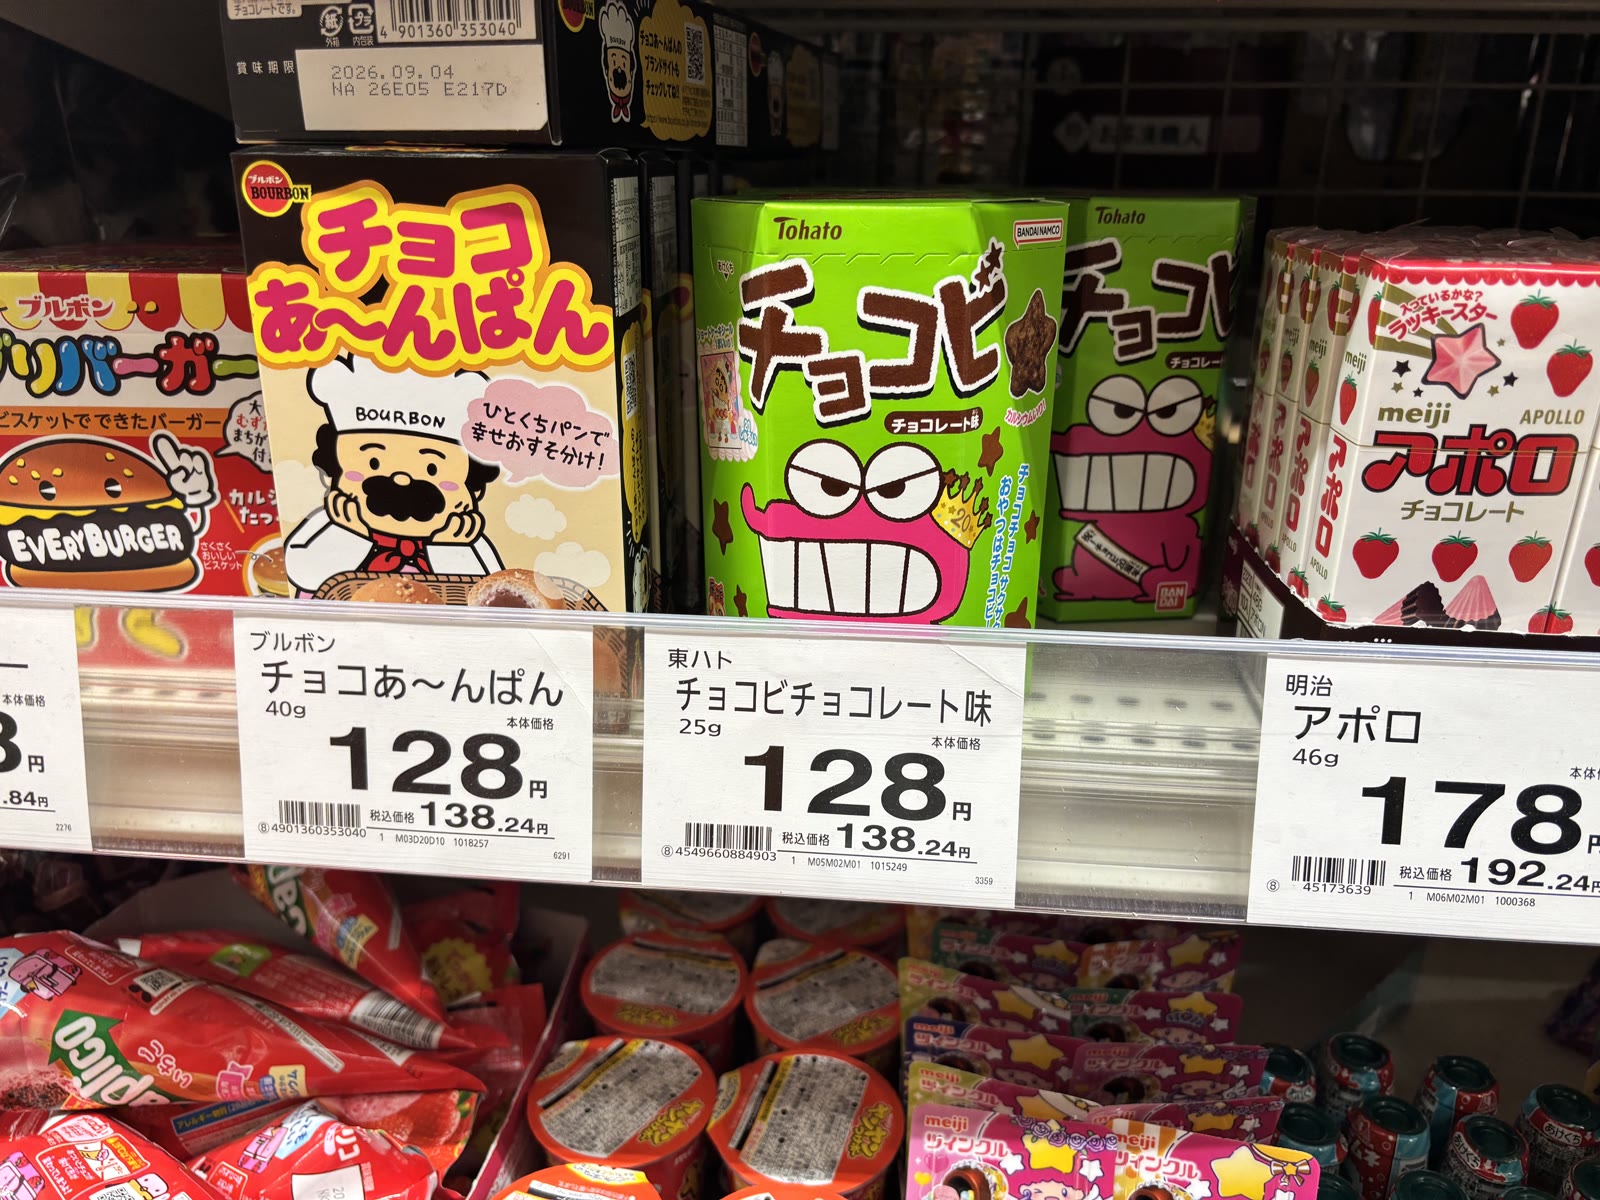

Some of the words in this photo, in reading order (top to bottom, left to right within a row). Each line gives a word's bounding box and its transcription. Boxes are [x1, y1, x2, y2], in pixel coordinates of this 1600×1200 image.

[380, 26, 388, 39] 4
[399, 23, 453, 39] 901360
[460, 22, 517, 38] 353040
[236, 60, 295, 76] 賞味期限
[331, 64, 455, 80] 2026.09.04
[332, 82, 355, 97] NA
[369, 82, 430, 97] 26E05
[443, 81, 507, 97] E217D
[248, 174, 283, 185] ブルボン
[251, 186, 309, 201] BOURBON
[1095, 206, 1146, 225] Tohato
[773, 216, 843, 240] Tohato
[317, 198, 533, 282] チョコ
[18, 294, 114, 320] ブルボン
[1400, 289, 1484, 316] 入っているかな?
[738, 238, 1006, 413] チョコビ
[1388, 301, 1498, 341] ラッキースター
[1309, 338, 1328, 359] meiji
[1345, 351, 1367, 374] meiji
[354, 406, 446, 429] BOURBON
[483, 402, 610, 447] ひとくちパンで
[891, 414, 980, 434] チョコレート味
[1378, 402, 1451, 429] meiji
[1519, 409, 1585, 425] APOLLO
[471, 424, 605, 470] 幸せおすそ分け!
[252, 449, 273, 465] 付
[1361, 424, 1579, 496] アポロ
[238, 507, 280, 526] たっ
[1401, 500, 1525, 523] チョコレート
[200, 541, 232, 552] さくさく
[1281, 533, 1297, 553] APOLLO
[201, 550, 237, 561] おいしい
[203, 560, 243, 571] ビスケット
[1309, 556, 1328, 580] APOLLO
[1160, 588, 1184, 598] BAN
[250, 631, 336, 653] ブルボン
[668, 648, 732, 670] 東ハト
[261, 660, 563, 707] チョコあ～んぱん
[1285, 674, 1333, 697] 明治
[265, 701, 306, 718] 40g
[676, 676, 992, 728] チョコビチョコレート味
[506, 716, 554, 731] 本体価格
[679, 719, 722, 737] 25g
[1294, 704, 1421, 744] アポロ
[931, 736, 982, 751] 本体価格
[1292, 748, 1339, 767] 46g
[369, 809, 415, 825] 税込価格
[56, 823, 72, 832] 2276
[271, 823, 367, 839] 4901360353040
[395, 834, 445, 846] M03D20D10
[453, 837, 489, 849] 1018257
[781, 831, 830, 847] 税込価格
[553, 851, 570, 860] 6291
[675, 846, 777, 862] 4549660884903
[807, 857, 861, 870] M05M02M01
[870, 861, 908, 872] 1015249
[1399, 865, 1452, 882] 税込価格
[974, 876, 993, 886] 3359
[1302, 883, 1372, 896] 45173639
[1427, 892, 1485, 905] M06M02M01
[1495, 896, 1536, 908] 1000368
[919, 1068, 960, 1083] meiji
[924, 1114, 968, 1132] meiji
[1544, 1122, 1582, 1146] あけくち
[925, 1135, 1009, 1159] ツインクル
